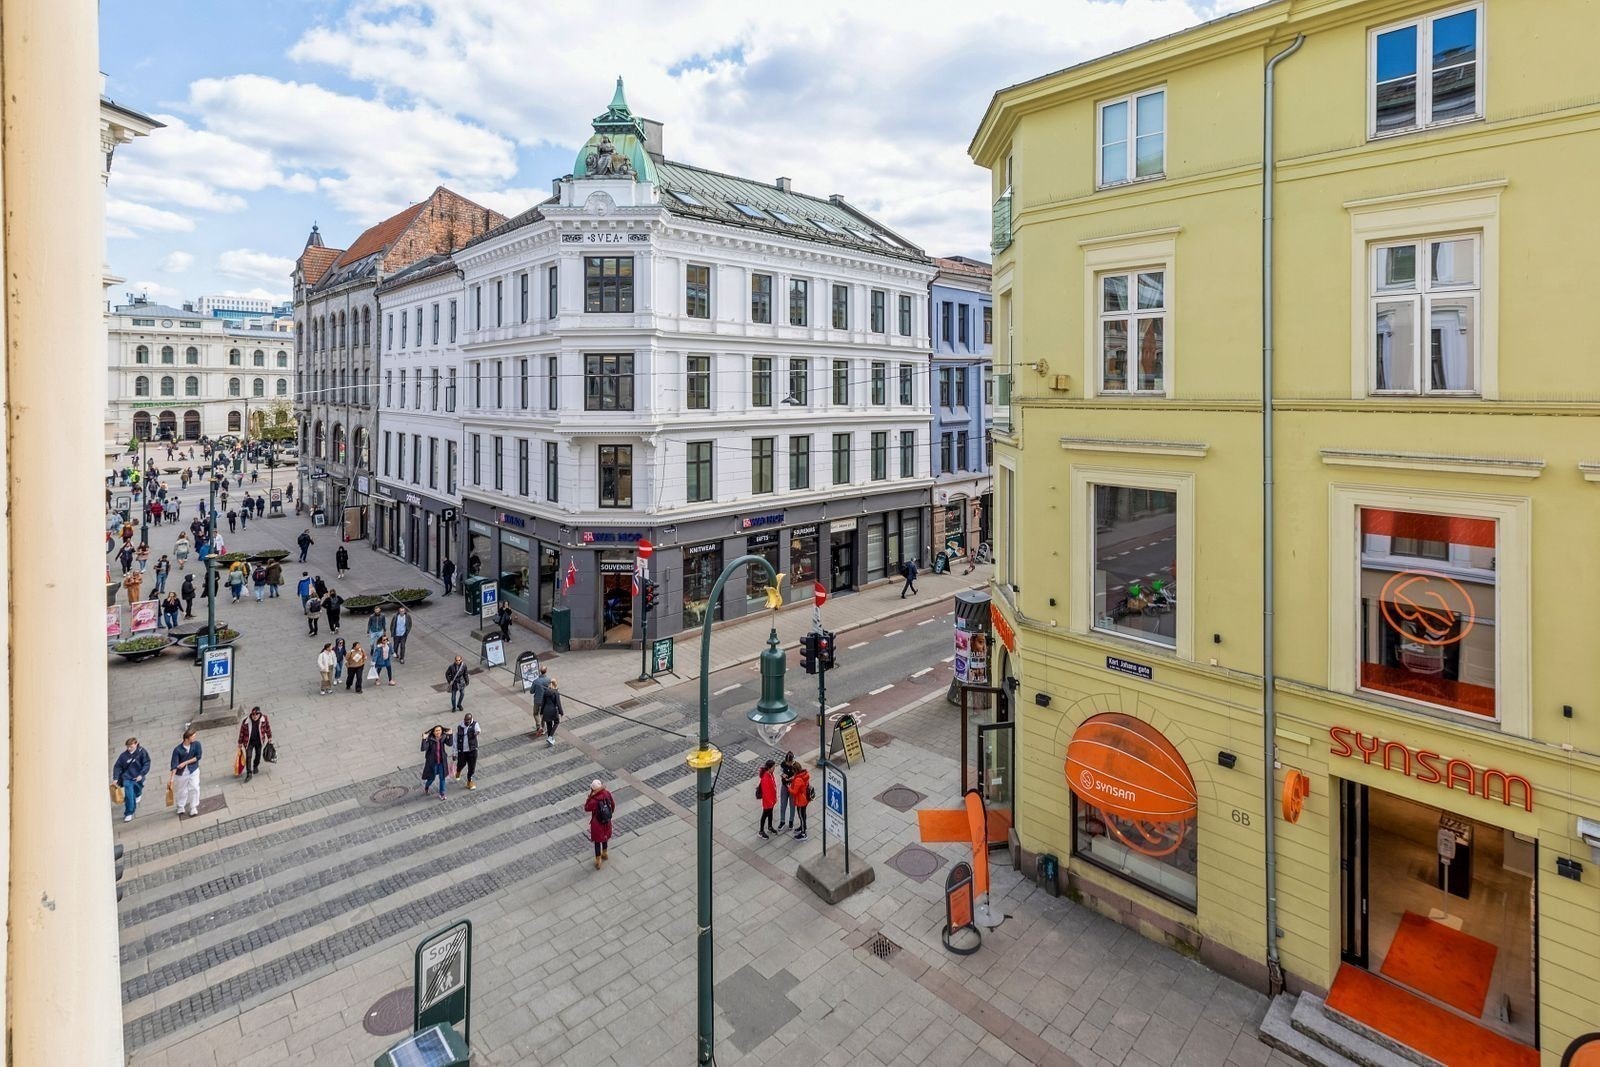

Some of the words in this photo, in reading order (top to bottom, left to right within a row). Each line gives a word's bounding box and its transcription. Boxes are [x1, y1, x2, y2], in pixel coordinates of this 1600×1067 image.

[591, 233, 620, 243] SVEA
[689, 543, 716, 554] KNITWEAR
[600, 563, 634, 571] SOUVENIRS
[209, 651, 228, 659] Sone
[1108, 658, 1119, 666] Karl
[1329, 726, 1533, 813] SYNSAM
[828, 771, 842, 787] Sone
[1095, 779, 1136, 803] SYNSAM
[1231, 808, 1251, 827] 6B
